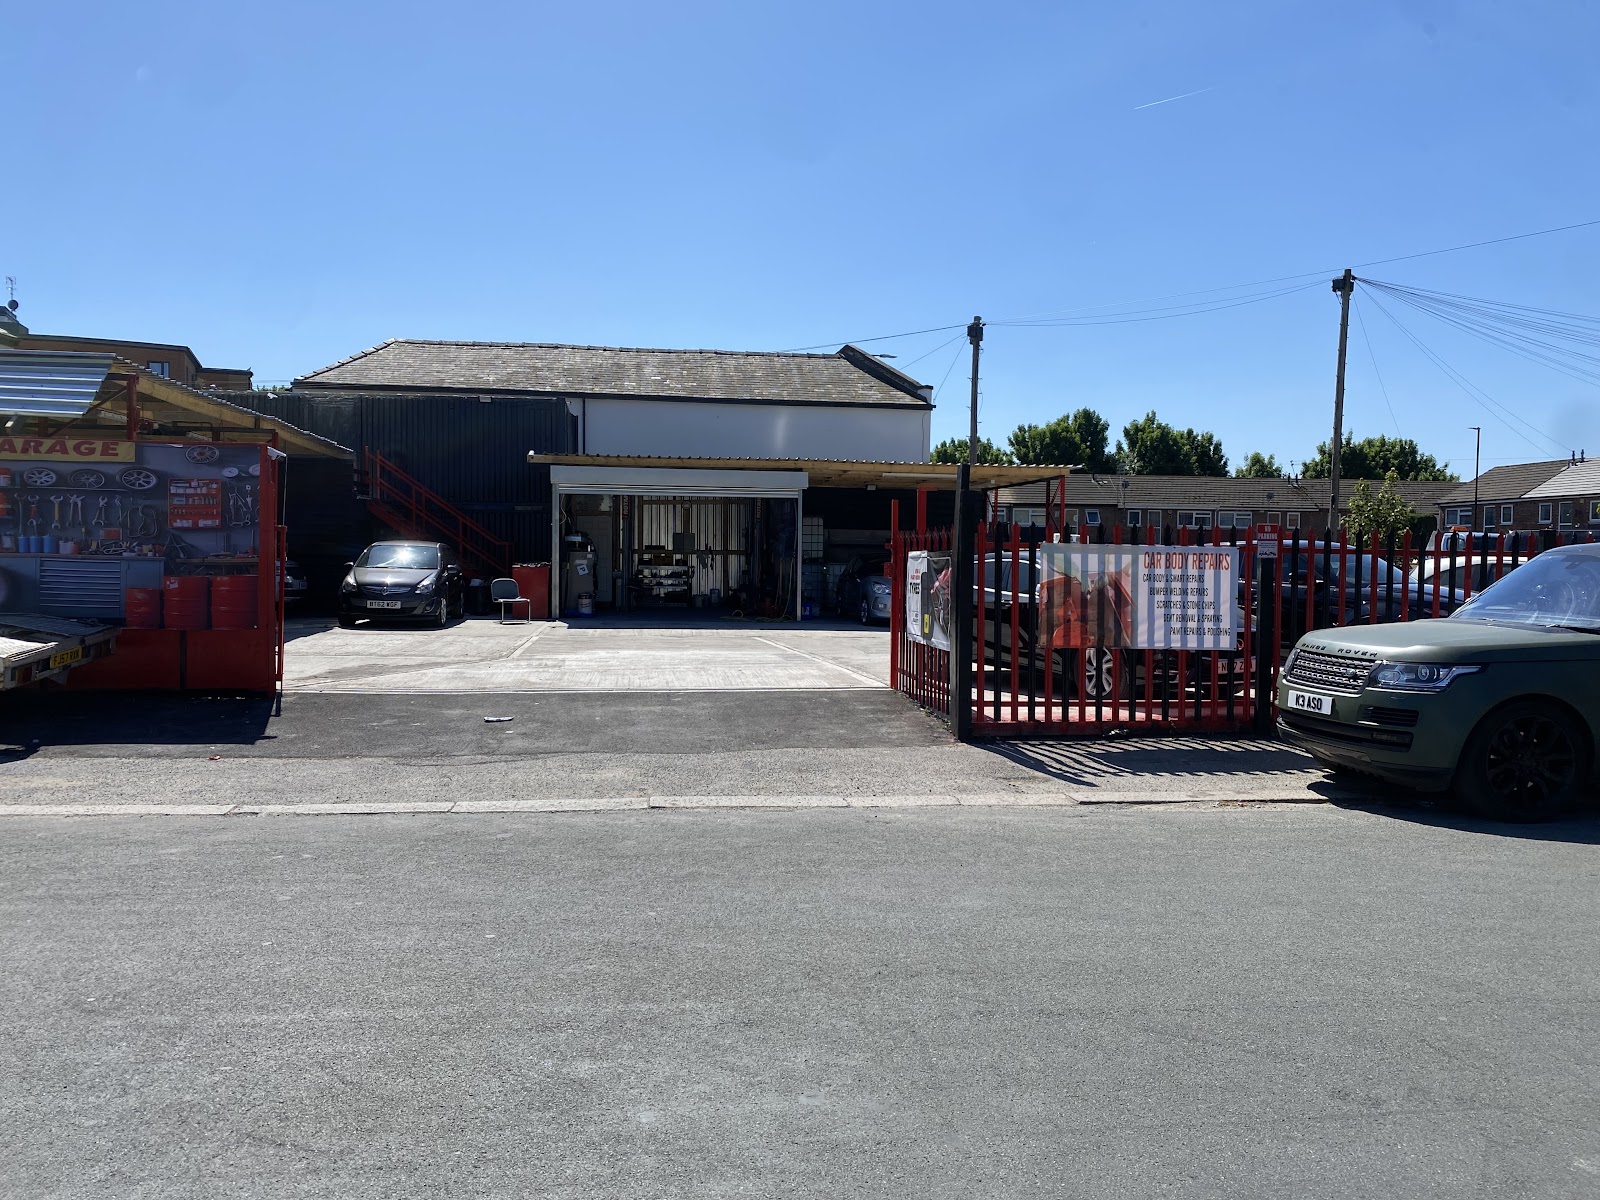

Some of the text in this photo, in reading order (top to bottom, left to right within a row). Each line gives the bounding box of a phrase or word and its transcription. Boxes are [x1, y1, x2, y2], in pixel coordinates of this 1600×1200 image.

[1143, 551, 1230, 571] CAR BODY REPAIRS
[1142, 573, 1152, 583] CAR
[1153, 573, 1165, 583] BODY
[1170, 574, 1185, 583] SMART
[1186, 574, 1205, 584] REPAIRS
[1149, 587, 1209, 597] BUMPER WELDING REPAIRS
[1156, 600, 1181, 609] SCRATCHES
[1187, 600, 1201, 610] STONE
[1202, 601, 1216, 610] CHIPS
[1163, 613, 1176, 623] DENT
[1176, 613, 1196, 623] REMOVAL
[1201, 614, 1223, 623] SPRAYING
[1170, 626, 1183, 636] PAINT
[1183, 626, 1202, 636] REPAIRS
[1207, 627, 1231, 637] POLISHING
[1301, 642, 1378, 658] RANGE ROVER
[1295, 693, 1306, 707] K3
